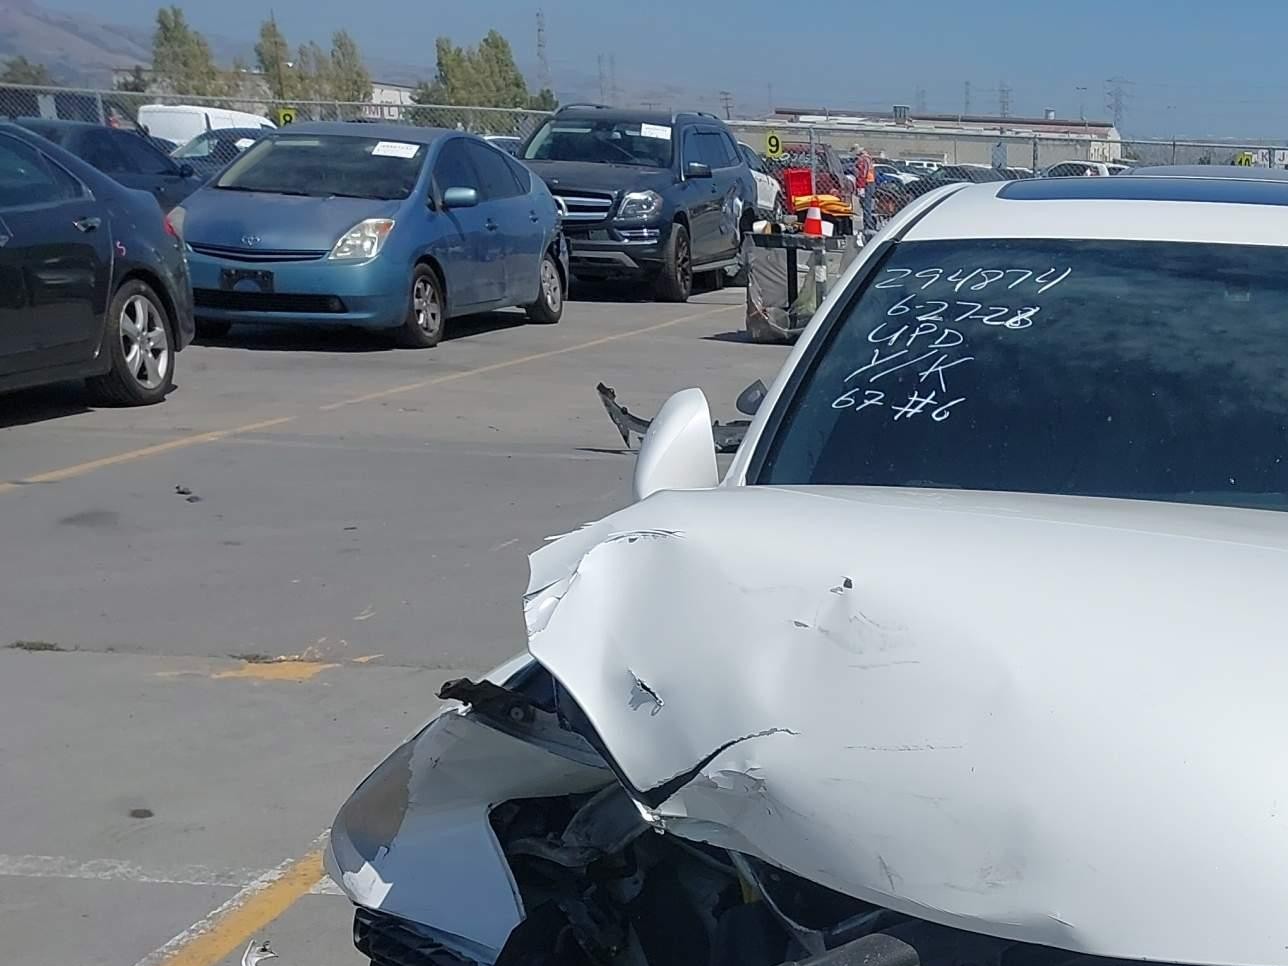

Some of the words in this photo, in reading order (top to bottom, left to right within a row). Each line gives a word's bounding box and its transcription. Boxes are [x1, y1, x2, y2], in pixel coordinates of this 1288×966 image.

[768, 135, 779, 153] 9
[875, 267, 1072, 294] 294874
[867, 322, 964, 348] UPD
